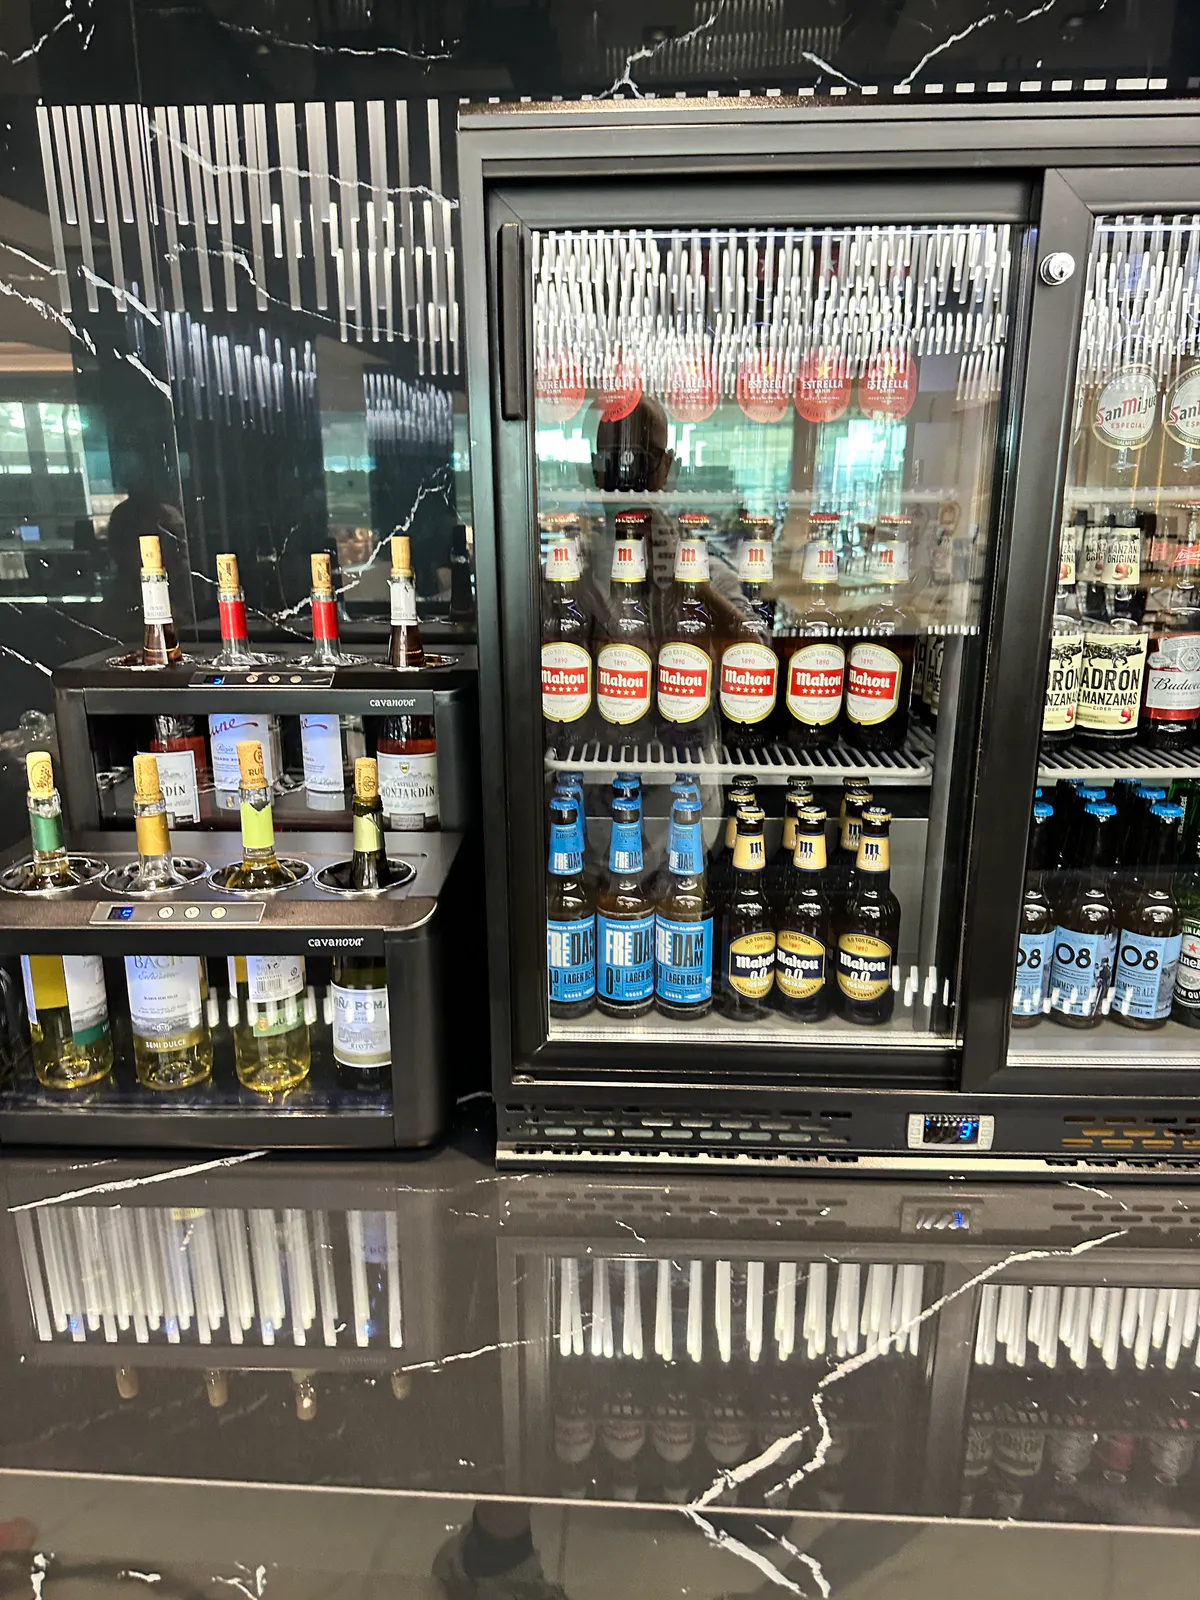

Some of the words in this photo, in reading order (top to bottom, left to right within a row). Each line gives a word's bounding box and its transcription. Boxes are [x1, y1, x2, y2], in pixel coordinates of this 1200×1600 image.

[802, 380, 843, 389] ESTRELLA
[867, 380, 908, 389] ESTRELLA
[542, 670, 584, 684] Mahou
[600, 671, 644, 688] Mahou
[660, 670, 702, 686] Mahou
[725, 669, 771, 686] Mahou
[796, 672, 841, 686] Mahou
[850, 670, 890, 688] Mahou
[1080, 666, 1140, 691] ADRÓN
[370, 698, 416, 707] cavanova
[1082, 690, 1138, 706] MANZANAS
[308, 937, 364, 947] cavanova
[855, 938, 878, 947] TOSTADA
[736, 953, 774, 968] Mahou
[777, 949, 819, 970] Mahou
[840, 952, 886, 972] Mahou
[564, 972, 584, 984] LAGER
[626, 970, 644, 984] LAGER
[666, 971, 686, 985] LAGER
[686, 974, 702, 986] BEER
[164, 1039, 186, 1048] DULCE
